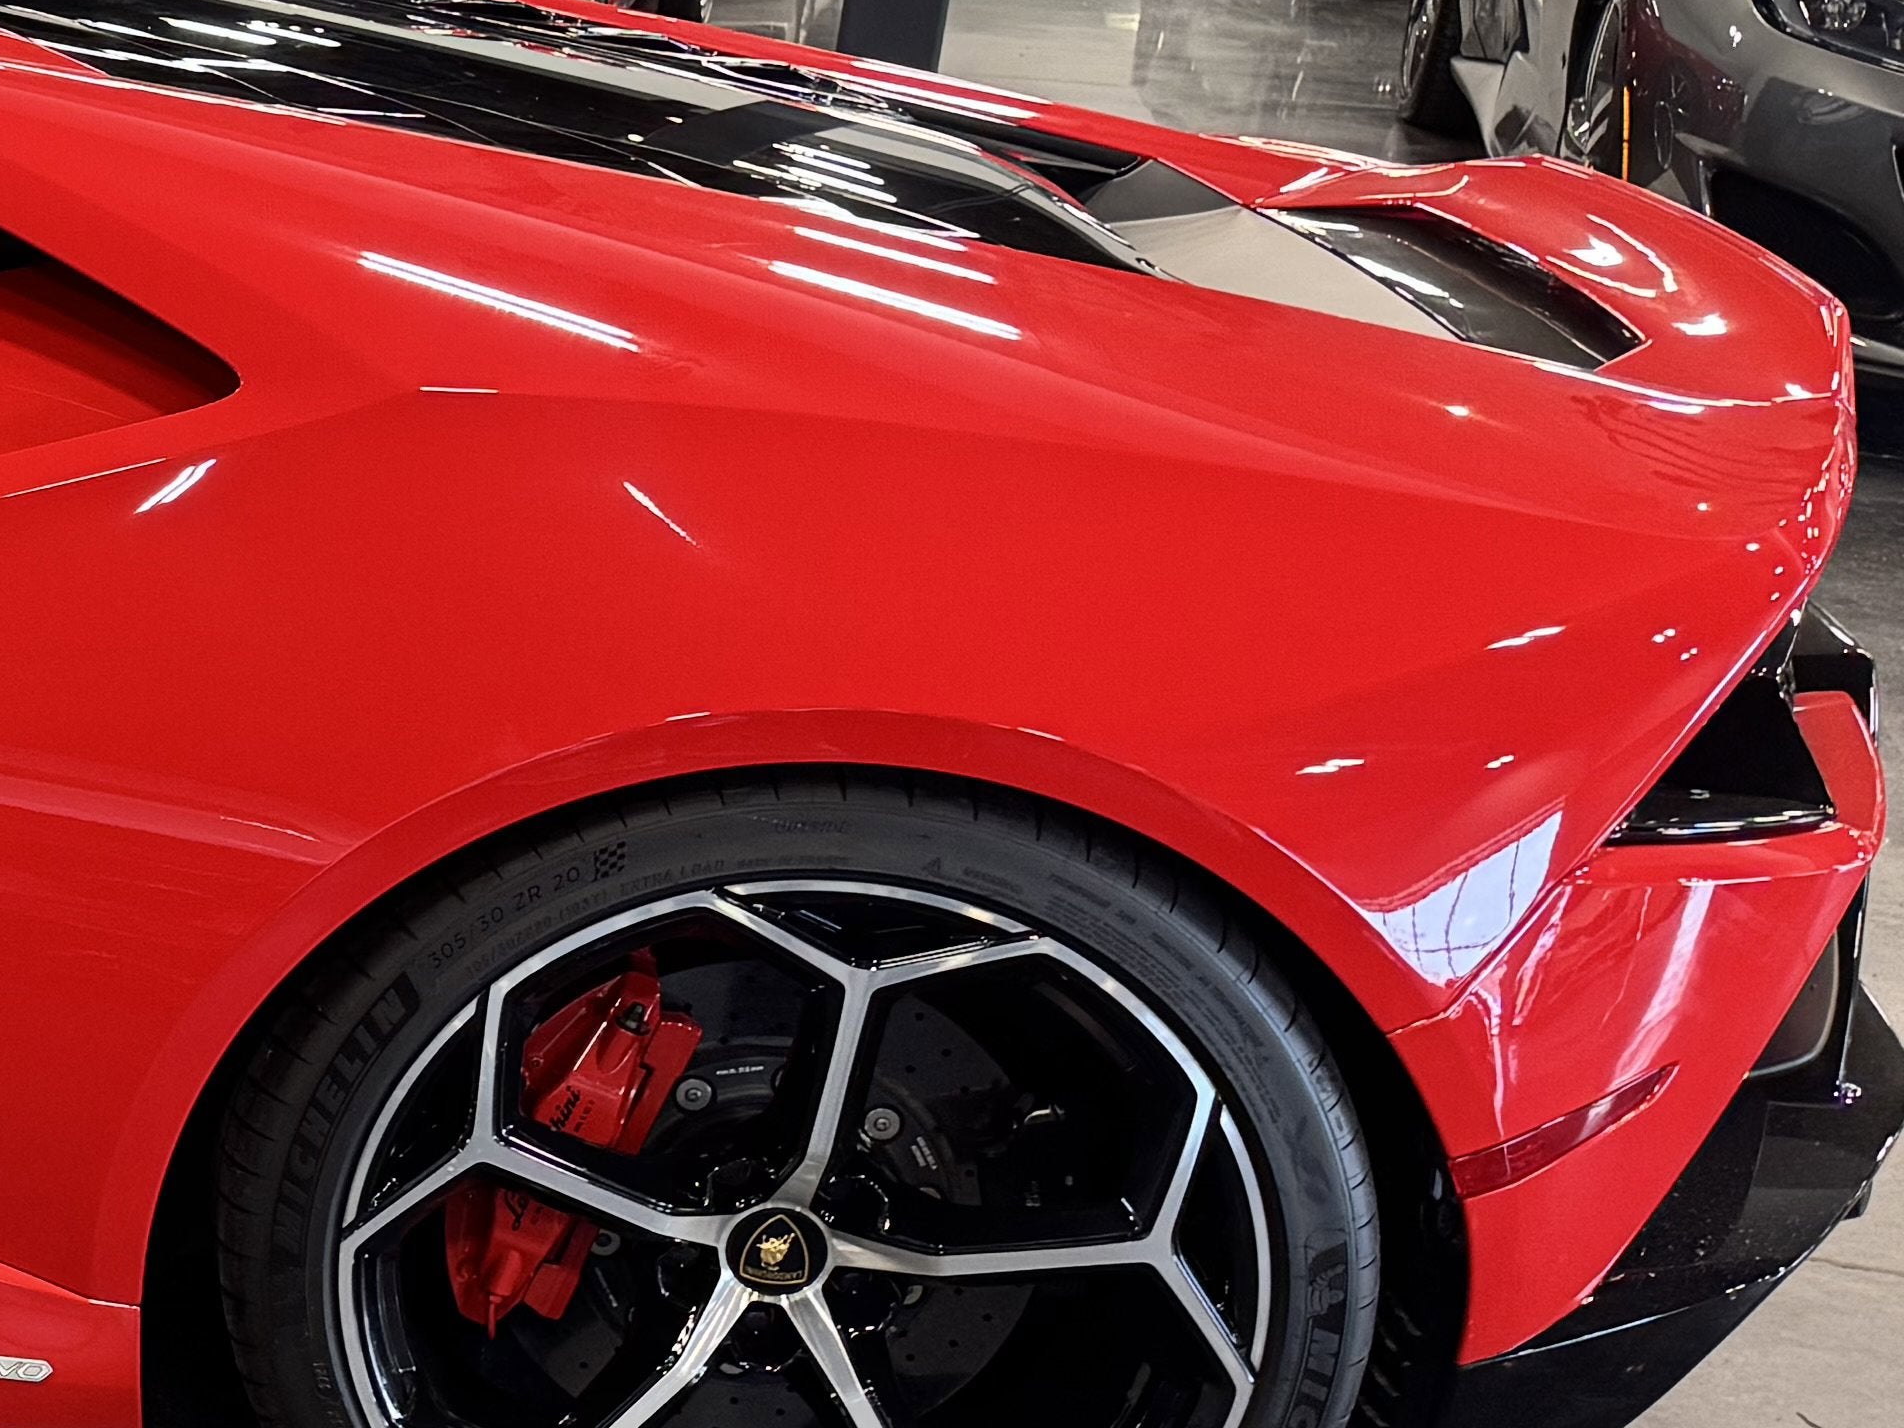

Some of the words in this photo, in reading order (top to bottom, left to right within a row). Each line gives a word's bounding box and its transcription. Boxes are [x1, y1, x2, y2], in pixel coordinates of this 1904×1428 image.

[513, 885, 544, 912] ZR
[553, 866, 580, 894] 20
[272, 985, 405, 1255] MICHELIN
